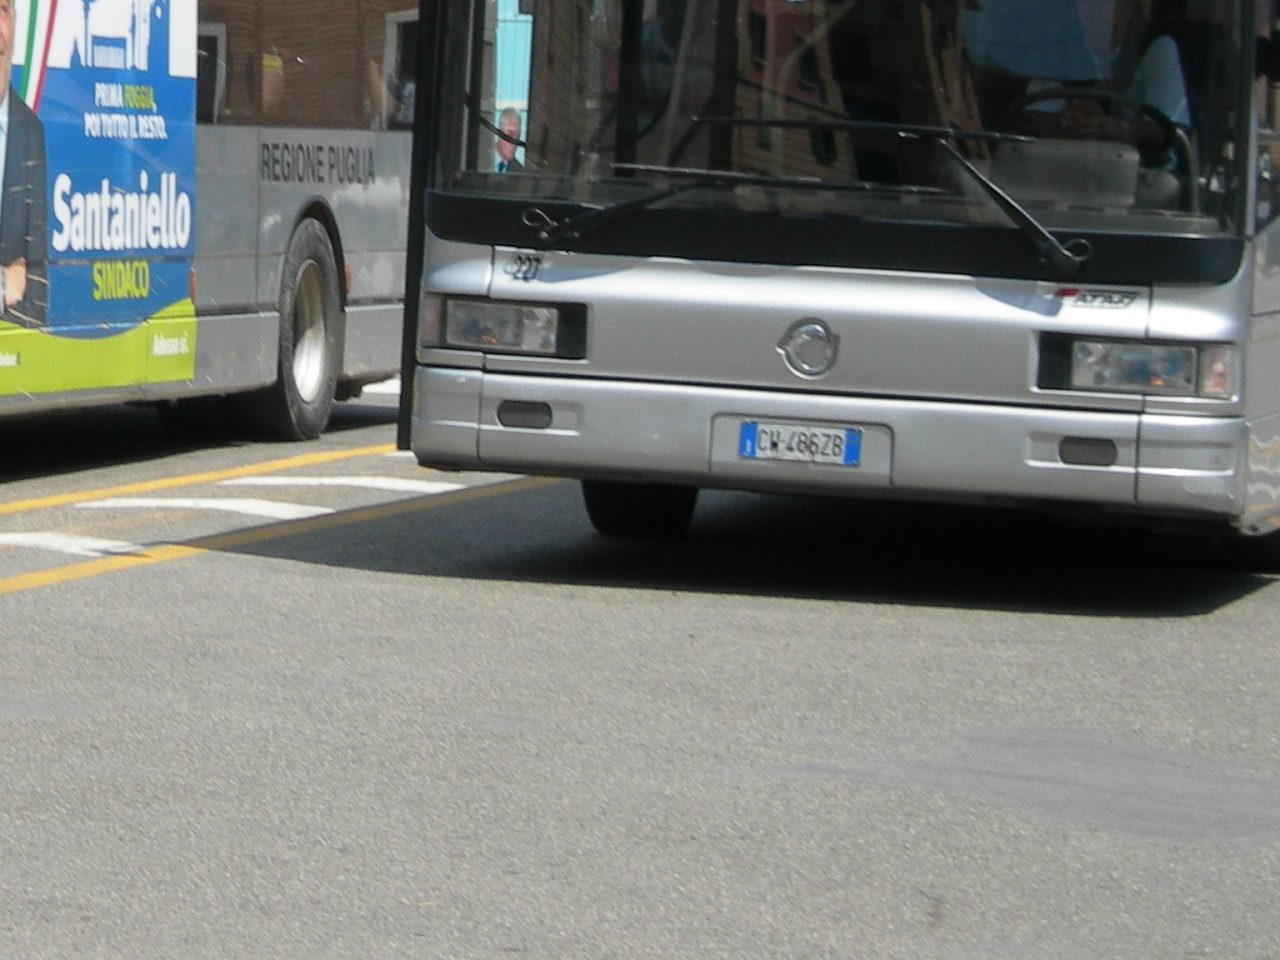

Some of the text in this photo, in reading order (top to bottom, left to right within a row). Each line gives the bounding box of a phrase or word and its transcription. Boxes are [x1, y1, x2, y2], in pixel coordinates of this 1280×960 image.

[261, 142, 376, 185] REGIONE PUGLIA
[51, 168, 191, 253] Santaniello
[91, 260, 150, 302] SINDACO
